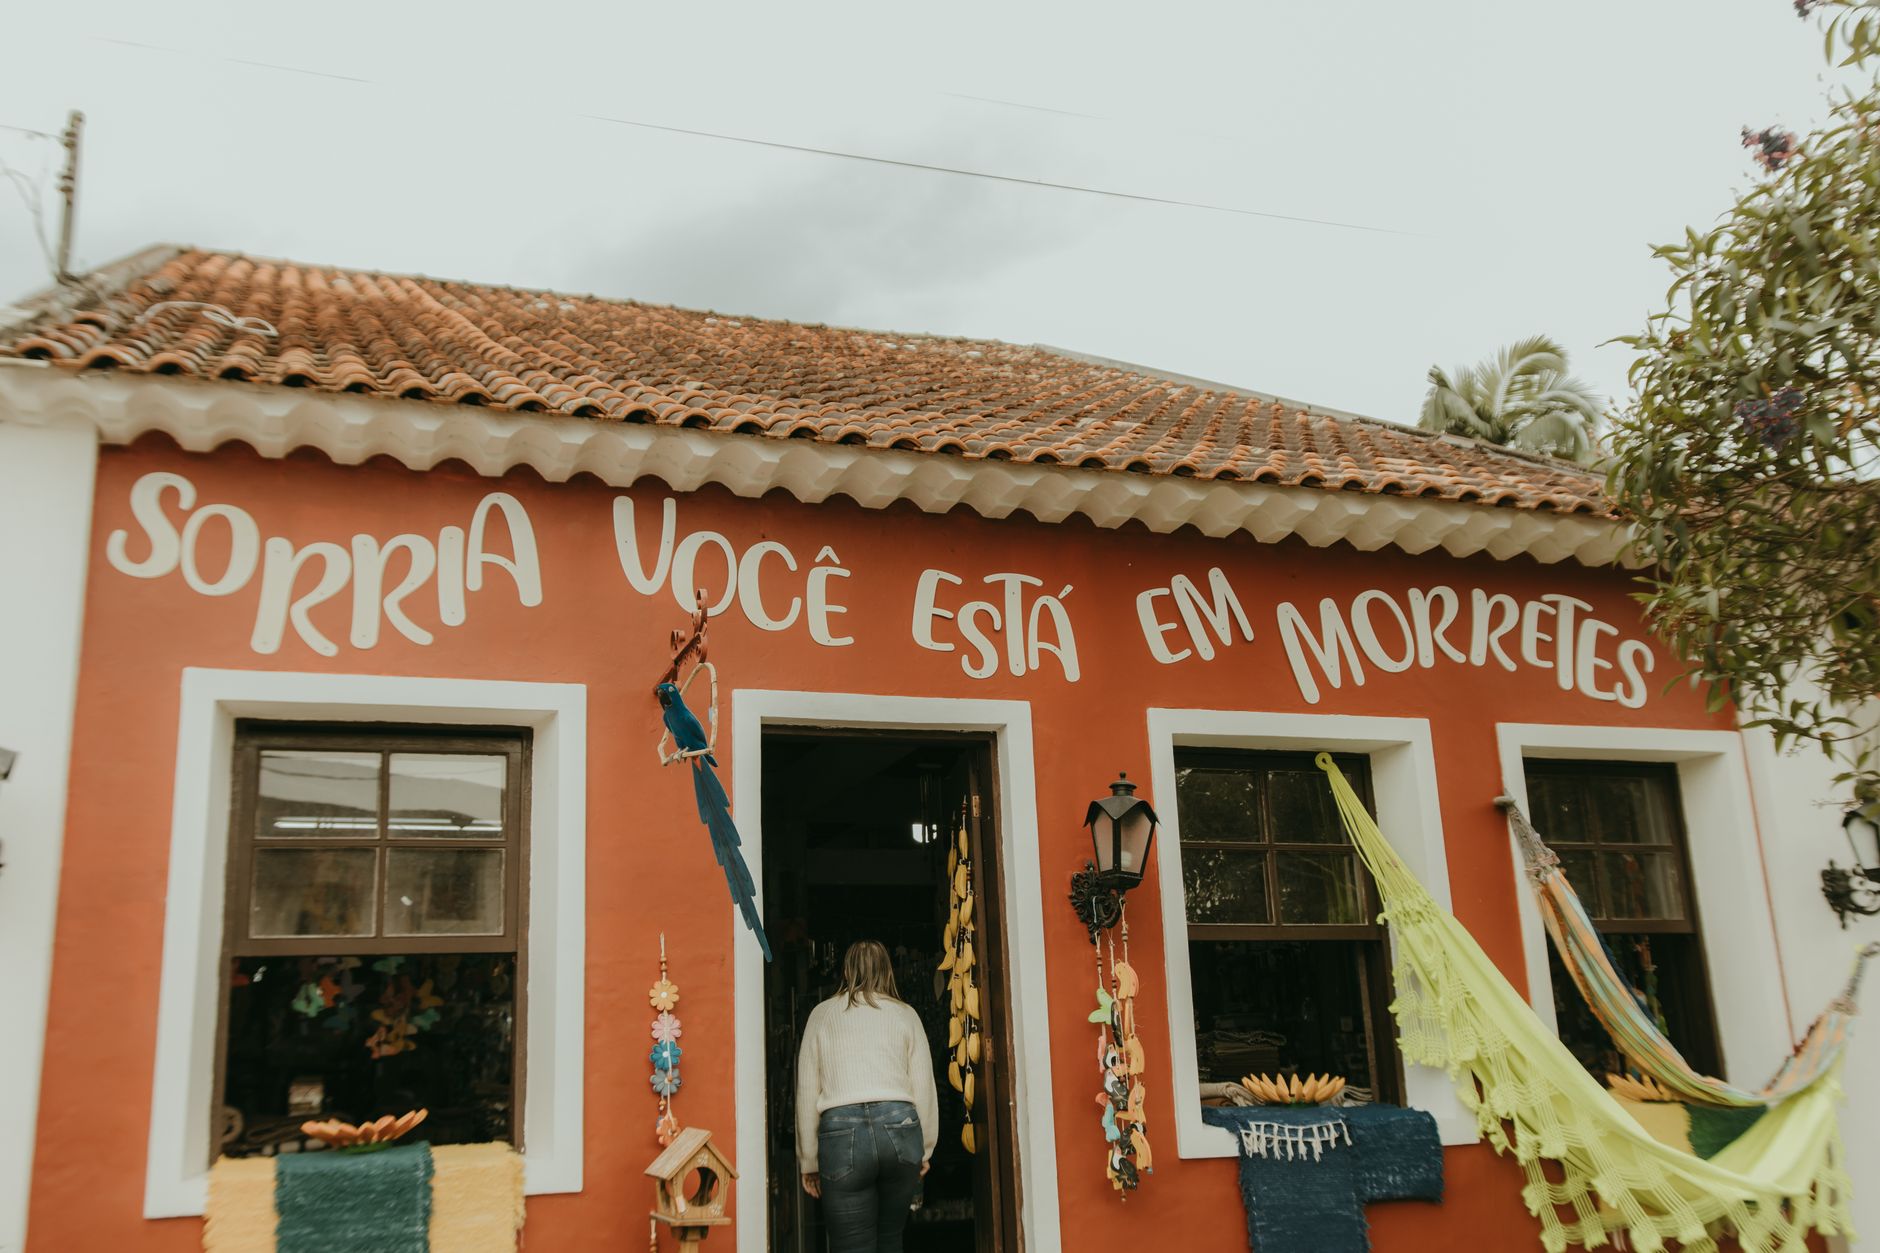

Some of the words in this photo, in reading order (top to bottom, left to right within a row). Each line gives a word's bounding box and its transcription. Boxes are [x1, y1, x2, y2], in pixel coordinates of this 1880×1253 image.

[107, 472, 543, 657] SORRIA
[612, 496, 855, 647] VOCÊ
[911, 569, 1082, 683] ESTÁ
[1135, 566, 1255, 664] EM
[1276, 585, 1656, 709] MORRETES
